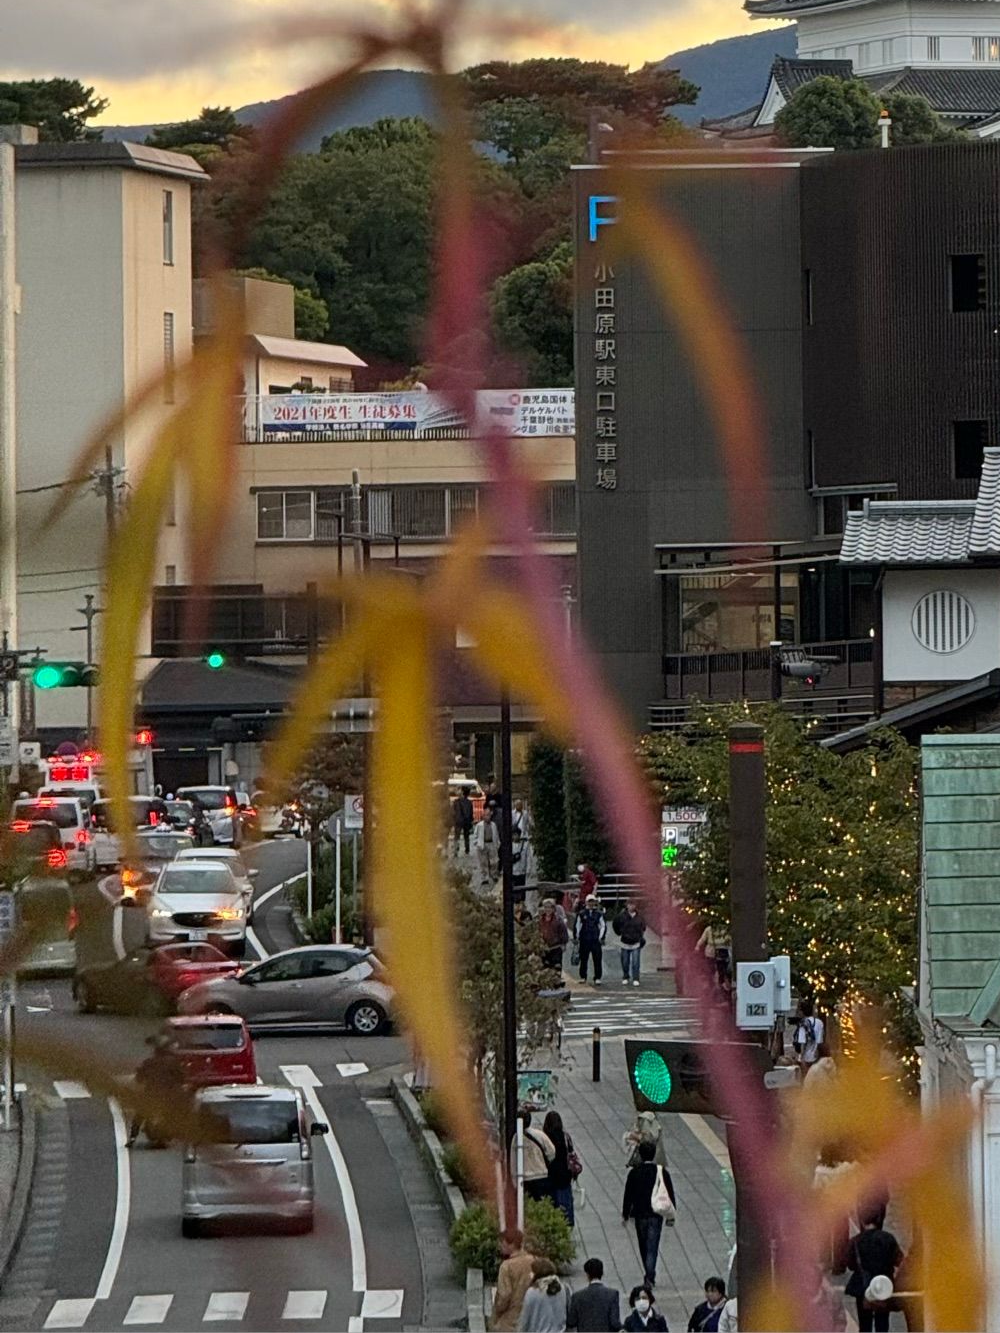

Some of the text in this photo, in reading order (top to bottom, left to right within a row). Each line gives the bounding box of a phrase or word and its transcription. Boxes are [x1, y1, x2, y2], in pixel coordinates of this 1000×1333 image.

[358, 404, 417, 420] 生徒募集
[594, 264, 617, 490] 小田原駅東口駐車場
